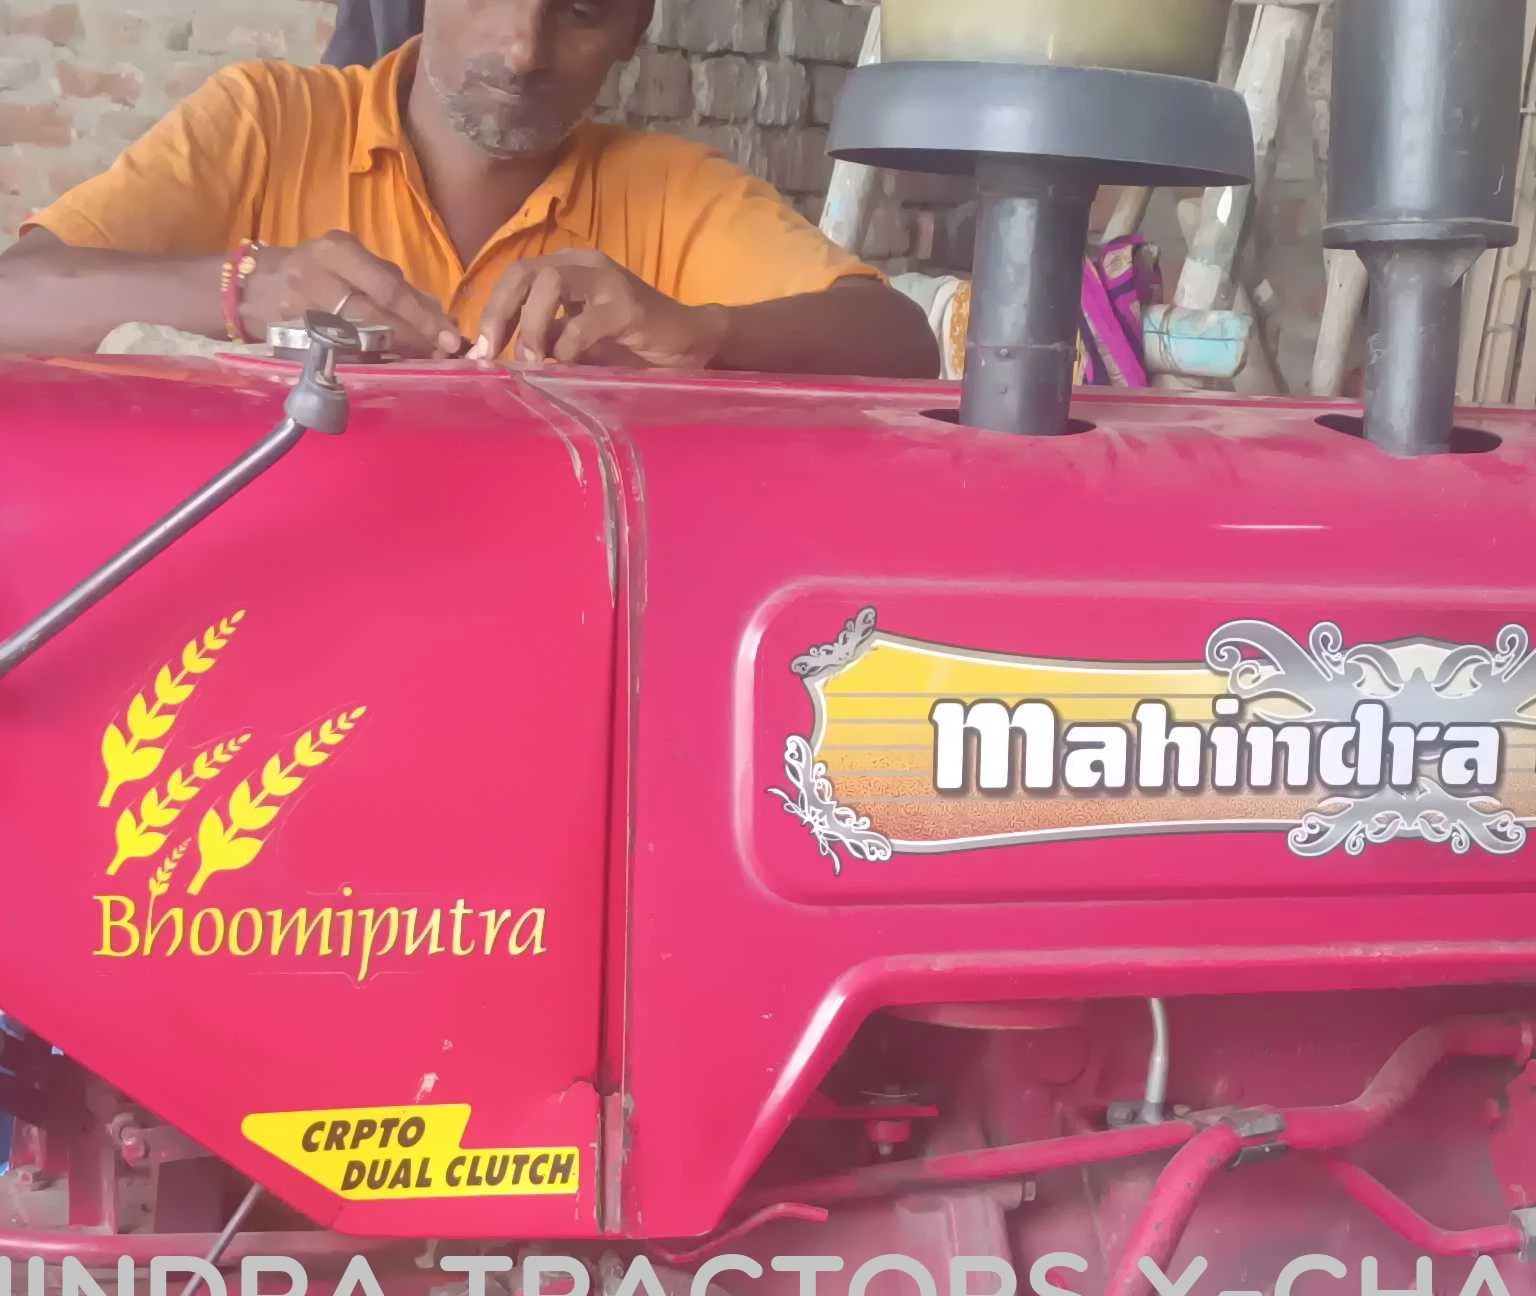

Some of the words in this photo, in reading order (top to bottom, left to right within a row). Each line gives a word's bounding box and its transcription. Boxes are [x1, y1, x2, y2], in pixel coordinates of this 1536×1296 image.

[931, 697, 1502, 790] Mahindra
[92, 880, 547, 982] Bhoomiputra
[301, 1116, 426, 1153] CRPTO
[340, 1157, 433, 1191] DUAL
[444, 1153, 574, 1187] CLUTCH
